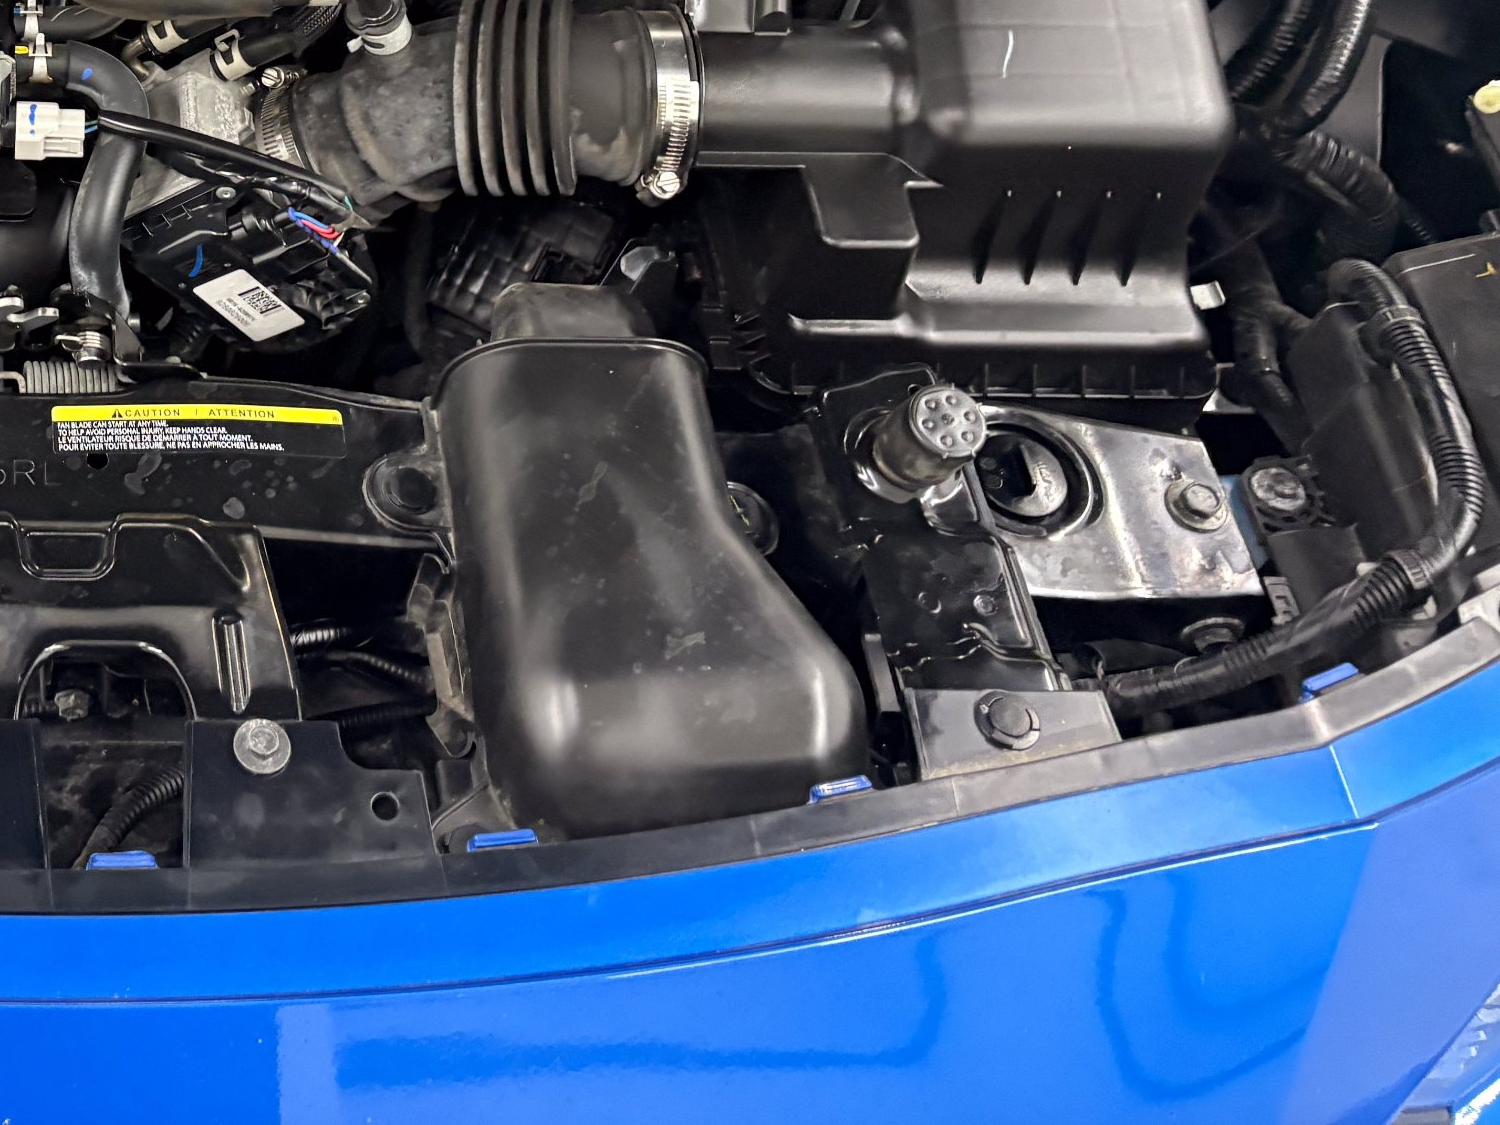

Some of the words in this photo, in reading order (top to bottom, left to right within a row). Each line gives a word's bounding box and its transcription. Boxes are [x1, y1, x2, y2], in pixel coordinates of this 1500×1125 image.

[125, 409, 180, 417] CAUTION
[208, 409, 275, 418] ATTENTION
[71, 421, 92, 429] BLADE
[108, 420, 128, 428] START
[106, 427, 140, 435] PERSONAL
[67, 435, 114, 443] VENTILATEUR
[58, 443, 79, 451] POUR
[104, 442, 128, 450] TOUTE
[166, 441, 177, 449] NE
[203, 441, 246, 449] APPROCHER
[259, 443, 285, 451] MAINS.
